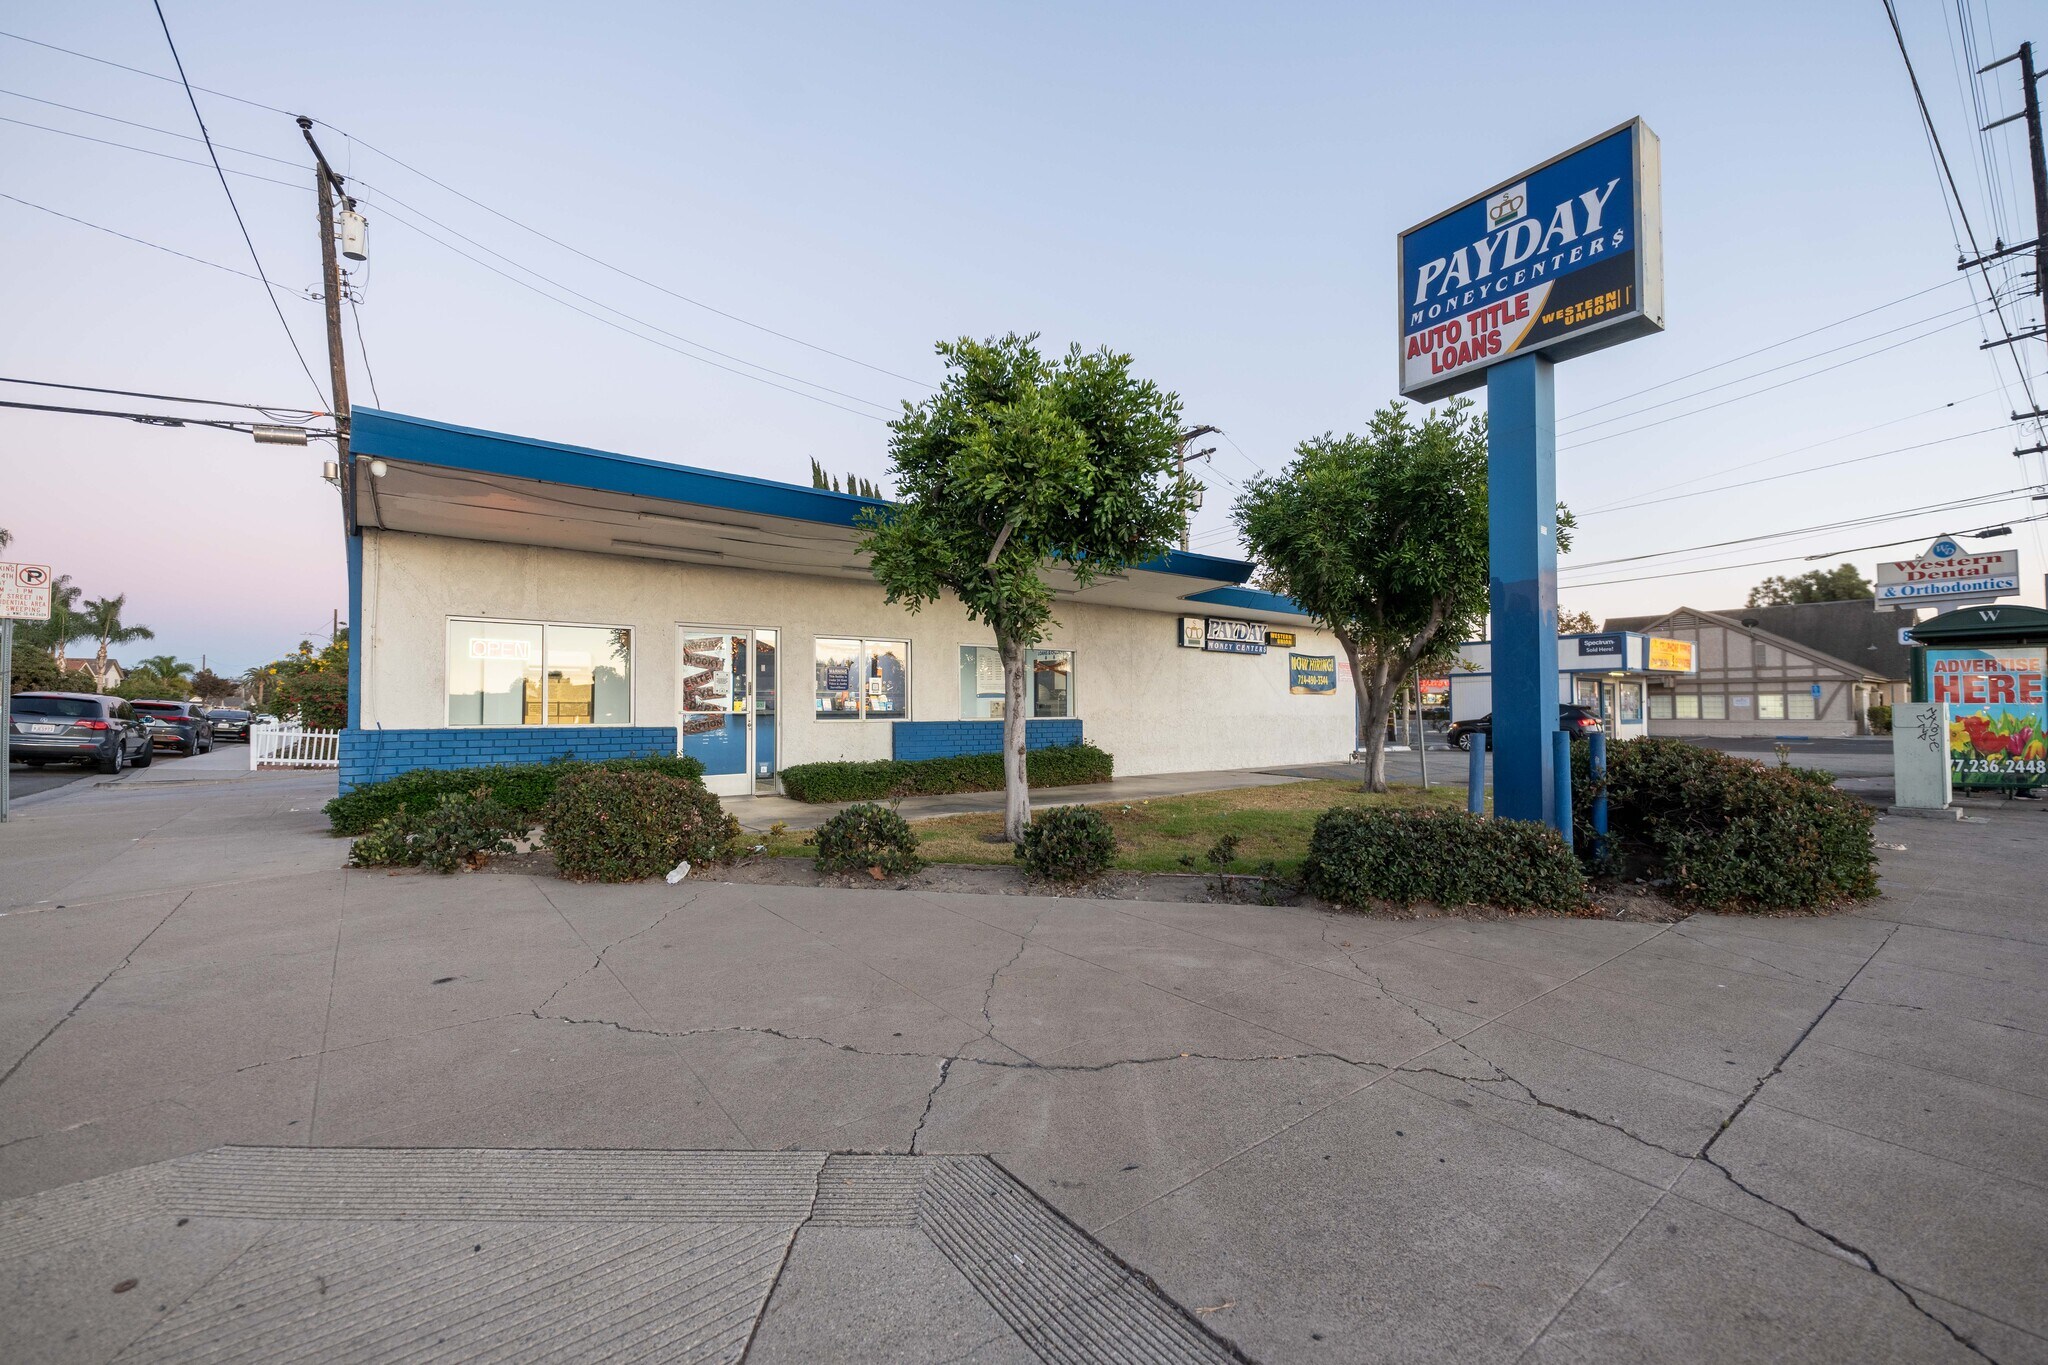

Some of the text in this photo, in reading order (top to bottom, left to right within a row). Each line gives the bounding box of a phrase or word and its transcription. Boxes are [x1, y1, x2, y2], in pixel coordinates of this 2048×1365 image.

[1413, 177, 1621, 306] PAYDAY
[1541, 290, 1617, 325] WESTERN
[1564, 300, 1617, 326] UNION
[1407, 293, 1530, 360] AUTO TITLE
[1431, 329, 1502, 375] LOANS
[1894, 554, 2004, 572] Western
[1907, 564, 1989, 581] Dental
[1884, 578, 2014, 598] & Orthodontics
[1979, 610, 2000, 622] W
[1207, 618, 1269, 642] PAYDAY
[1270, 632, 1293, 640] WESTERN
[472, 641, 527, 658] OPEN
[1208, 641, 1233, 650] MONEY
[1584, 639, 1613, 647] Spectrum
[1291, 656, 1309, 671] NOW
[1309, 657, 1334, 672] HIRING!
[1933, 658, 2041, 673] ADVERTISE
[1933, 673, 2044, 704] HERE
[684, 719, 723, 733] CAUTION
